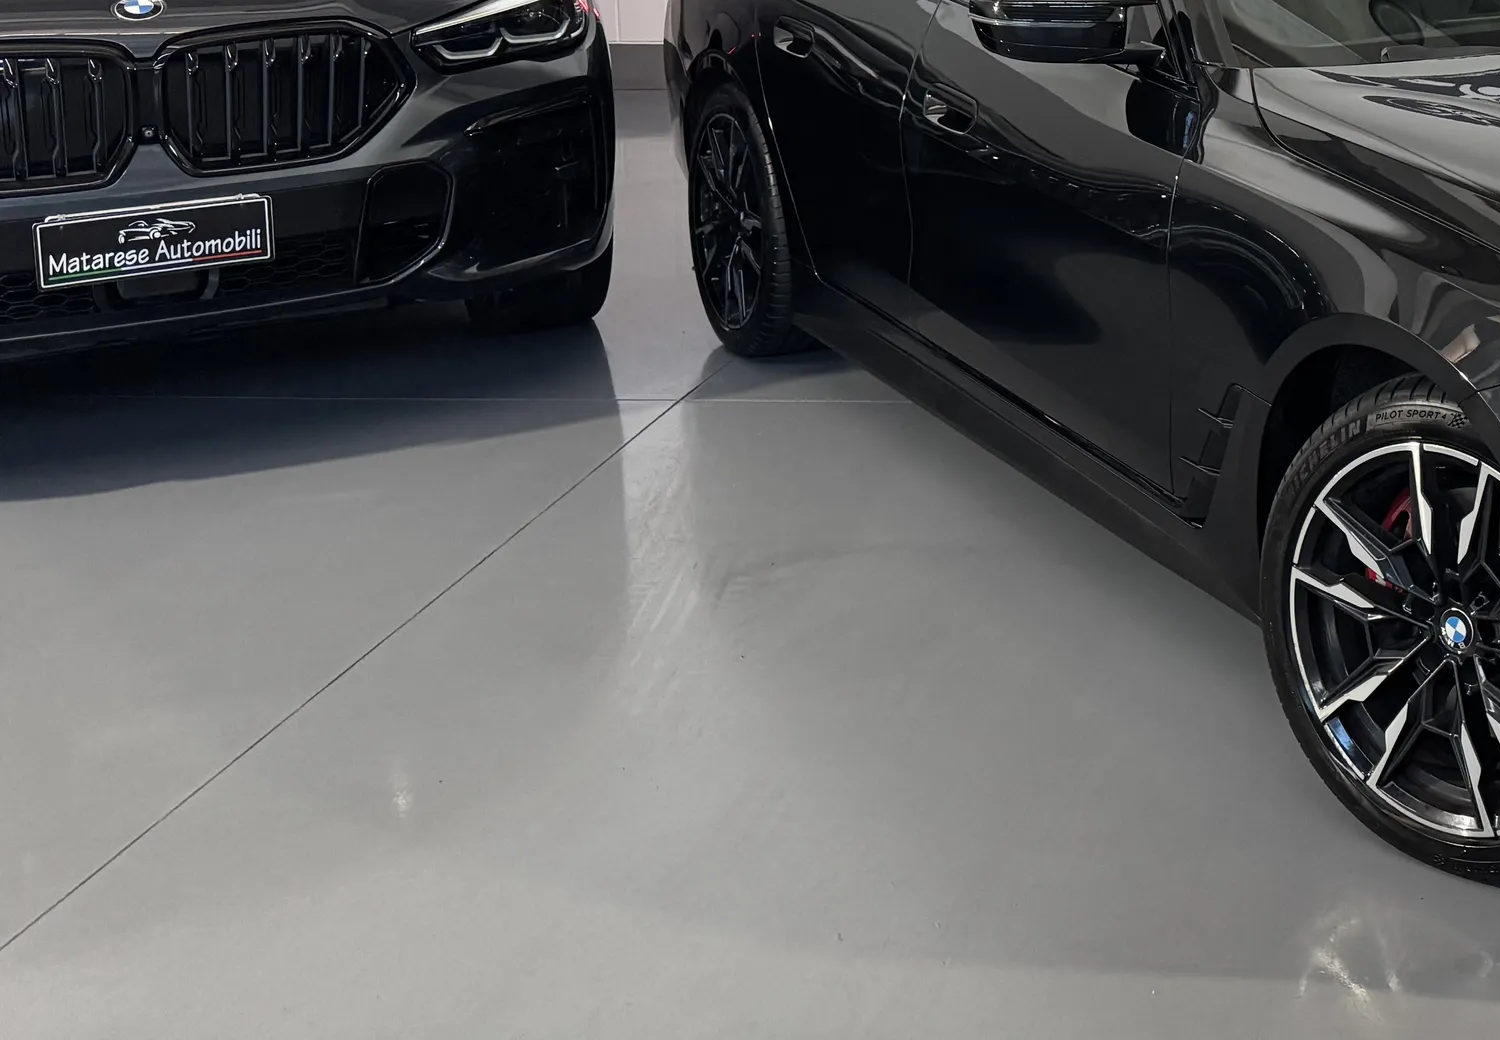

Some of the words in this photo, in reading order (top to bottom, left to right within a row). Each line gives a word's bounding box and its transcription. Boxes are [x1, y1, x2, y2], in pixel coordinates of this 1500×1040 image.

[48, 248, 150, 276] Matarese
[155, 228, 262, 261] Automobili
[1375, 410, 1402, 422] PILOT
[1406, 409, 1441, 419] SPORT
